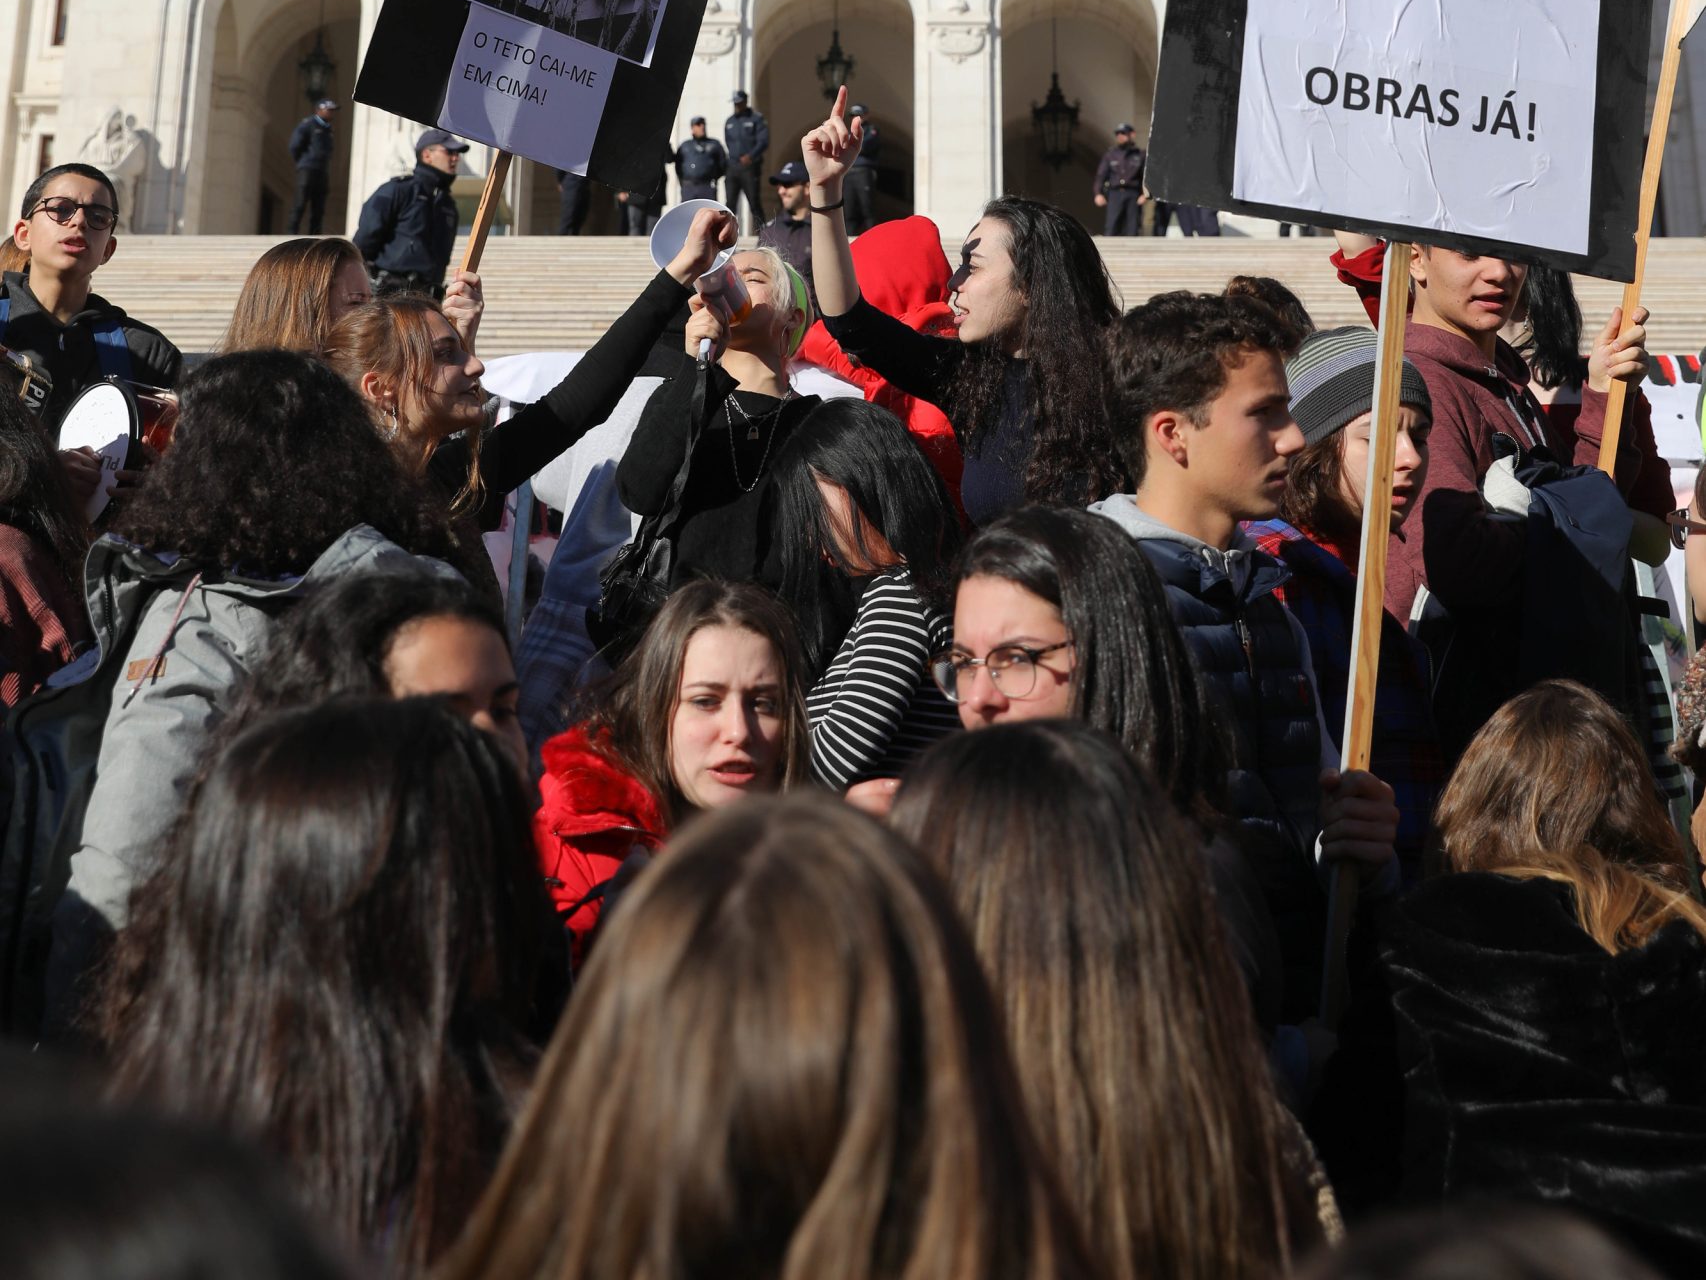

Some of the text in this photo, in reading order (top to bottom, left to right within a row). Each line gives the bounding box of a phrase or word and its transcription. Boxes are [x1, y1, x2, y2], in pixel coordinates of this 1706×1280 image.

[463, 63, 548, 106] EM CIMA!
[474, 32, 597, 88] O TETO CAI-ME
[1305, 66, 1537, 142] OBRAS JÁ!
